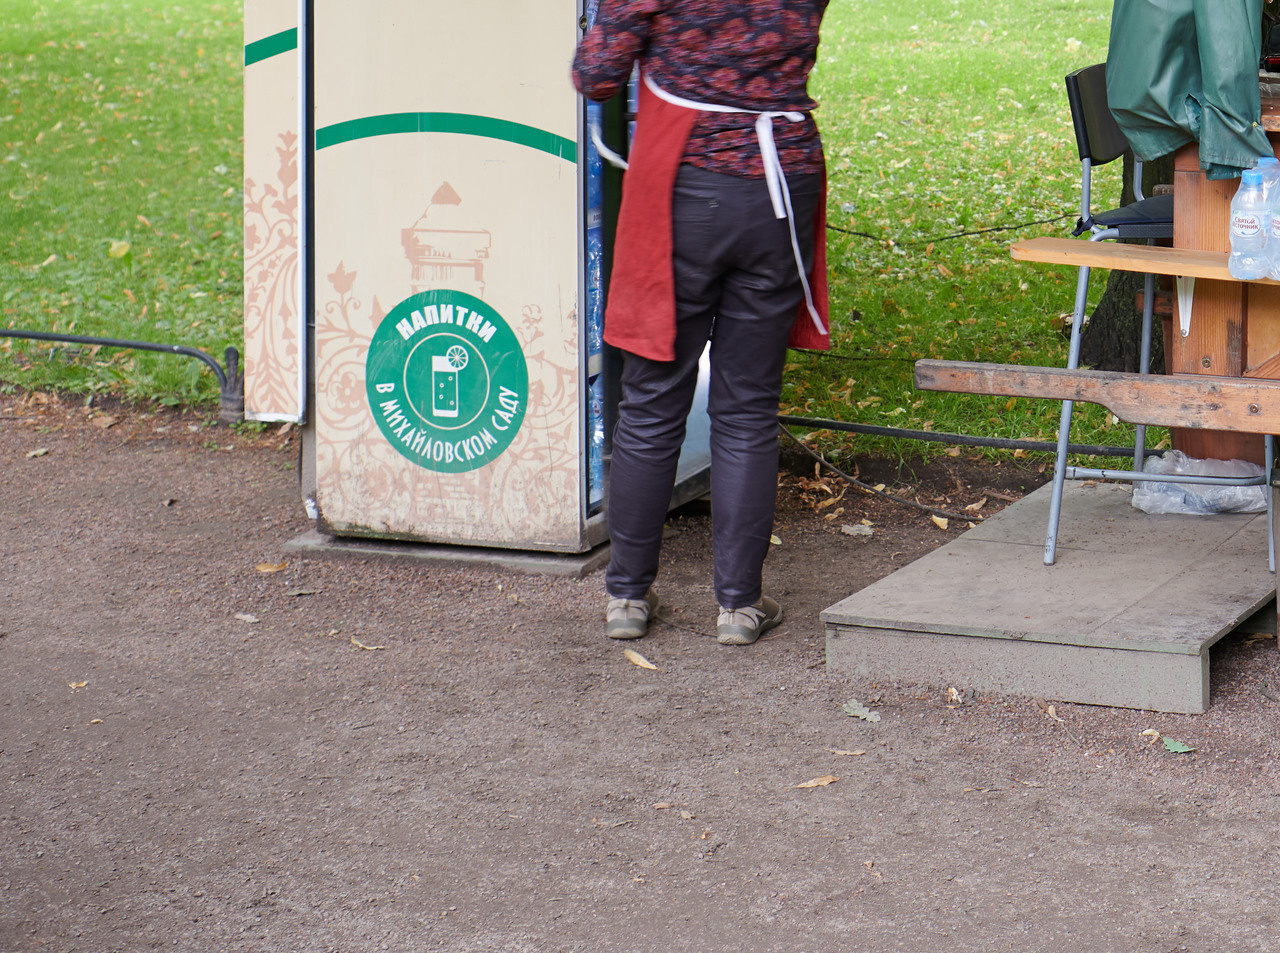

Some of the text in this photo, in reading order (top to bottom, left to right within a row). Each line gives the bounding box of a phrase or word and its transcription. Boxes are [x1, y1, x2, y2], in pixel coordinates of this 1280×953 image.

[395, 304, 497, 343] НАПИТКИ
[380, 399, 498, 463] МИХАЙЛОВСКОМ
[491, 386, 519, 430] САДУ
